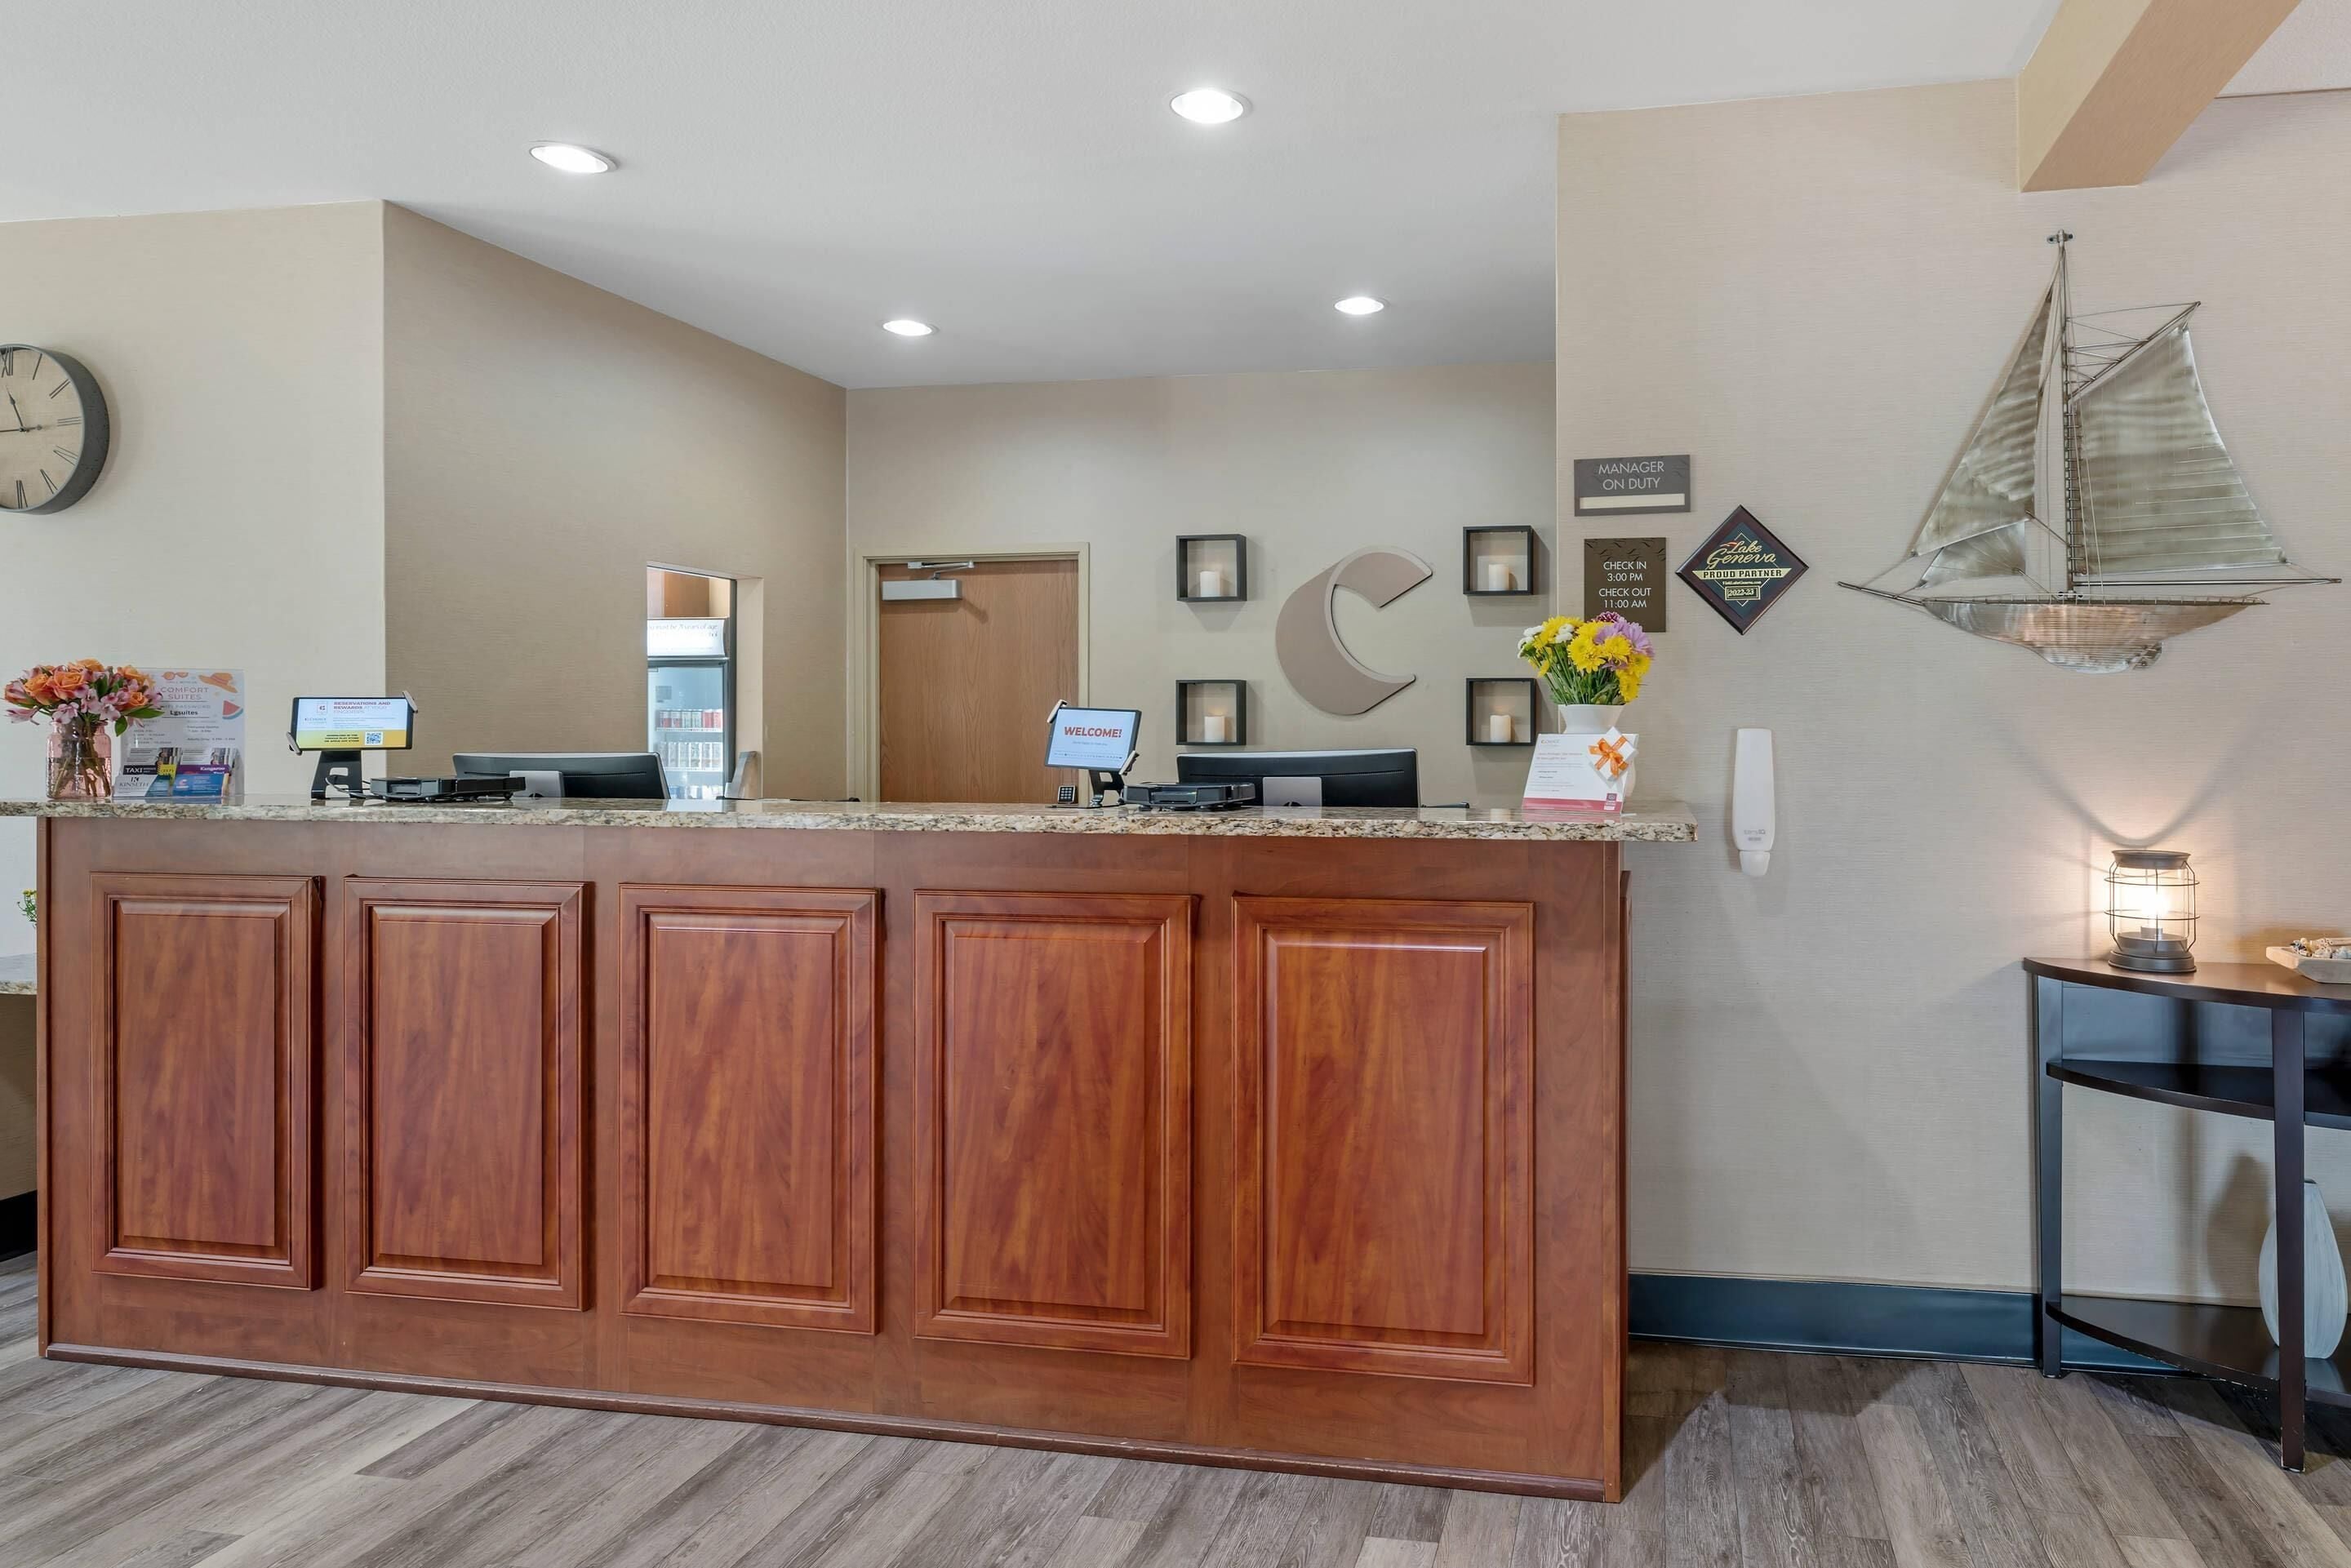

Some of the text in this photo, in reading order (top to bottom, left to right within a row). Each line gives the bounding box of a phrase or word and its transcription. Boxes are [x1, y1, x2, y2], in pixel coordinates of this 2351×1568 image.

[1598, 460, 1664, 475] MANAGER
[1602, 477, 1661, 491] ON DUTY
[1726, 540, 1762, 554] Lake
[1706, 548, 1777, 570] Geneva
[1602, 561, 1647, 571] CHECK IN
[1607, 572, 1643, 582] 3:00 PM
[1703, 569, 1782, 579] PROUD PARTNER
[1598, 587, 1651, 597] CHECK OUT
[1604, 599, 1647, 608] 11:00 AM
[1064, 726, 1122, 738] WELCOME!
